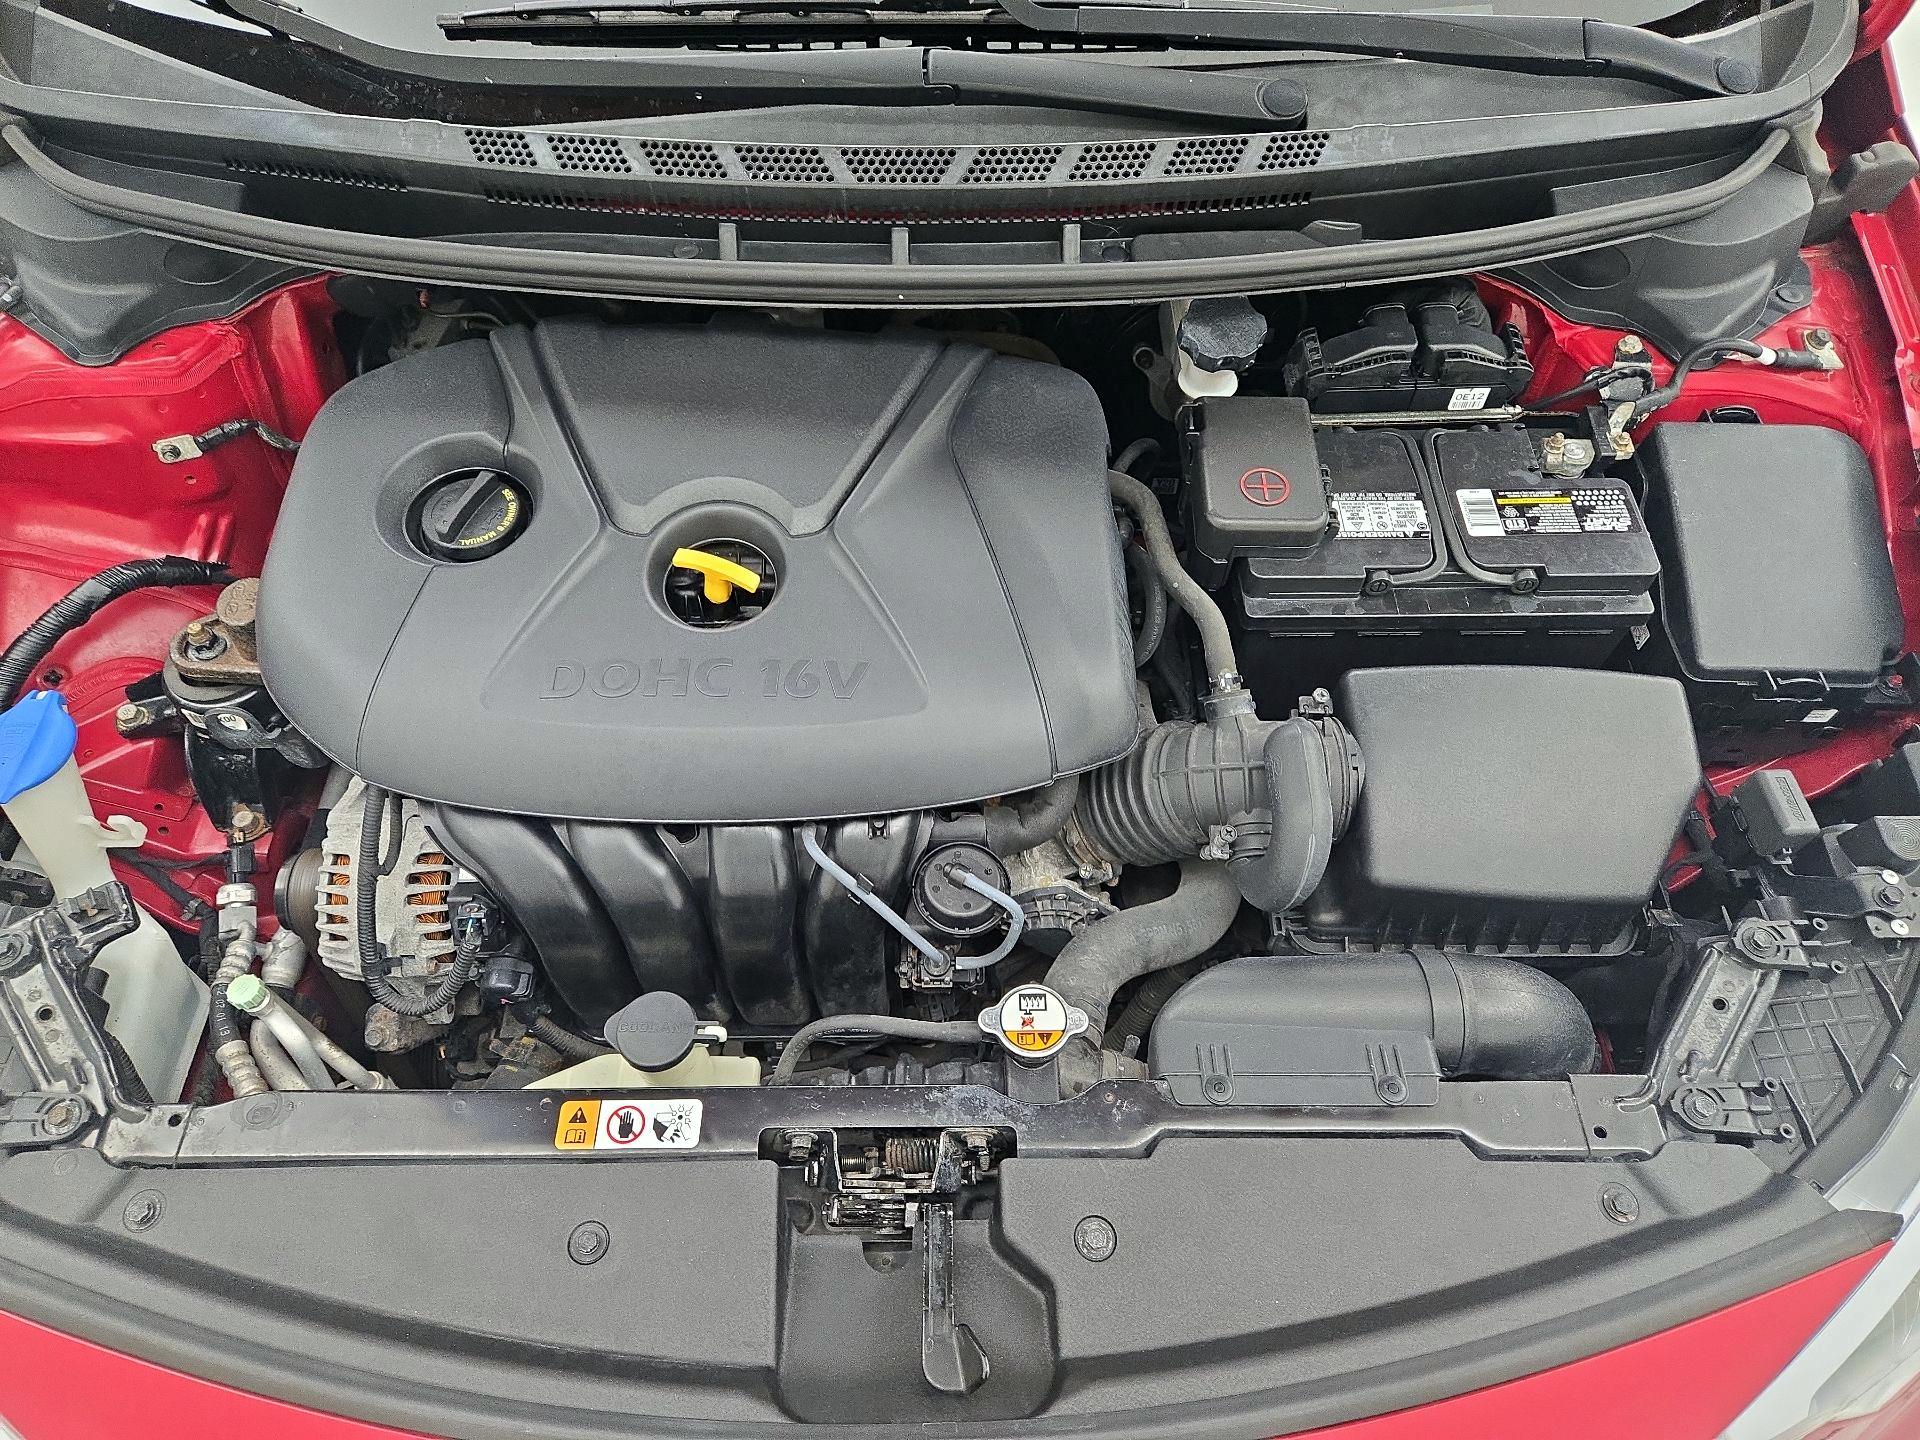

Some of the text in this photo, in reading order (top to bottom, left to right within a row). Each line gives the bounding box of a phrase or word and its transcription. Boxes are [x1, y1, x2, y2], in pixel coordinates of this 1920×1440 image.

[502, 489, 515, 501] SEE
[459, 530, 498, 546] MANUAL
[539, 657, 872, 700] DOHC 16V
